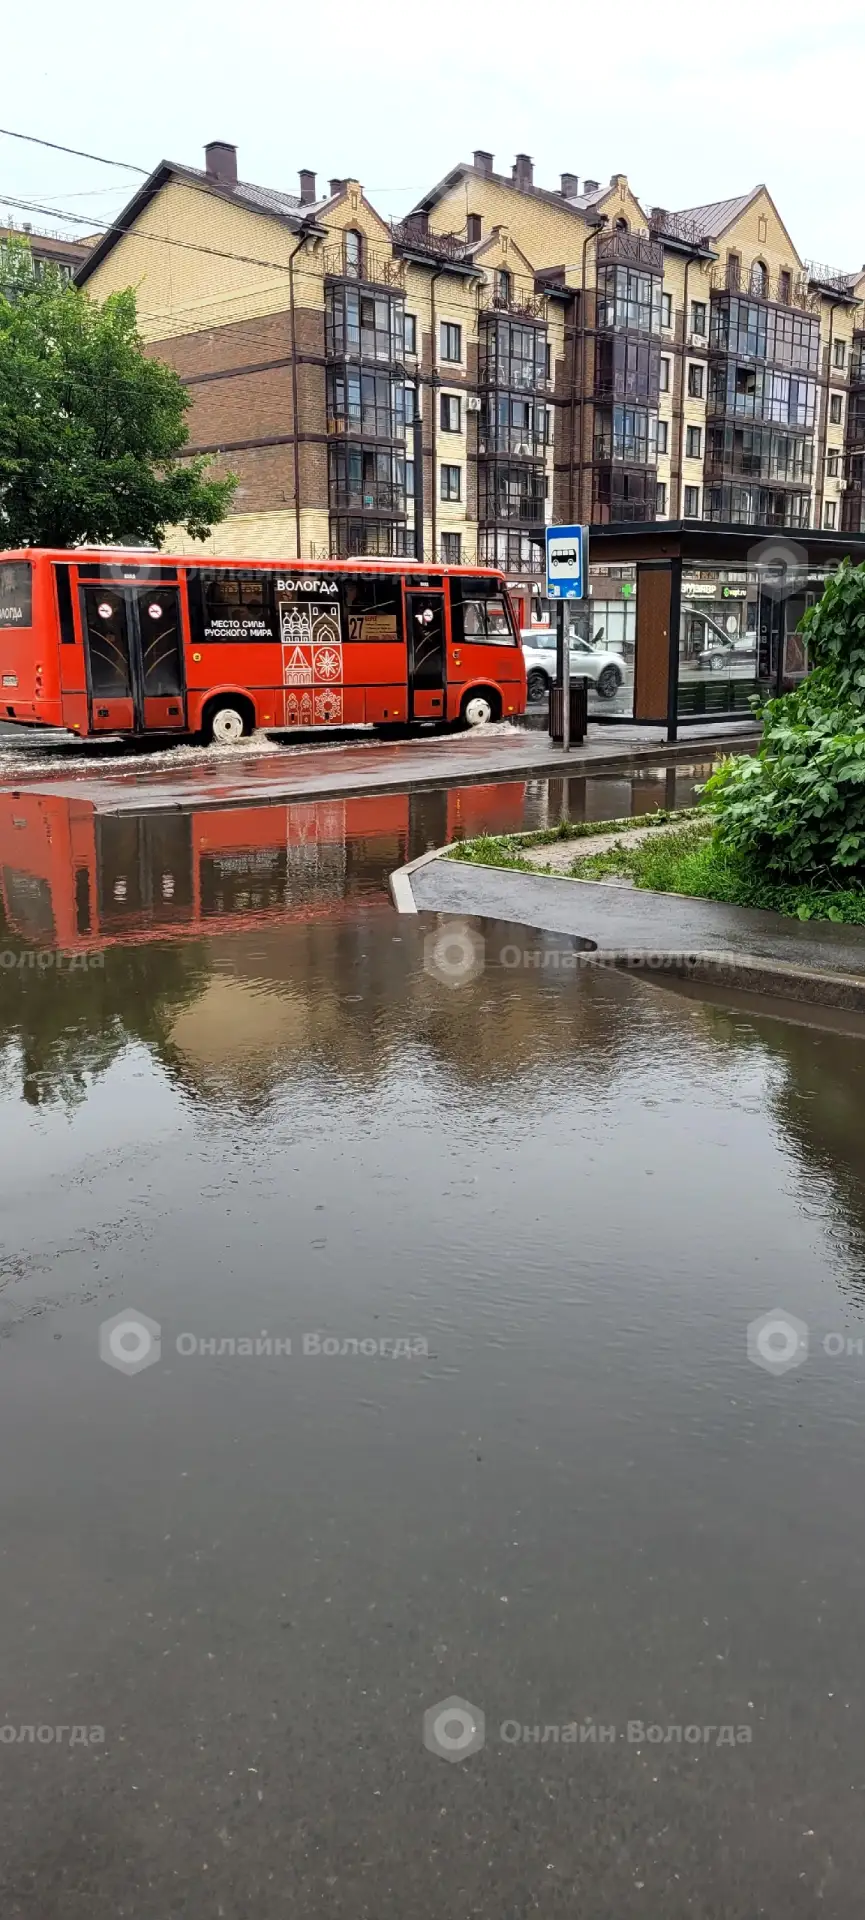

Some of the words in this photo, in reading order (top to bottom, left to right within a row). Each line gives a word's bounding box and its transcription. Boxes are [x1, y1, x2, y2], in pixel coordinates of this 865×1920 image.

[277, 580, 339, 594] ВОЛОГДА
[0, 607, 23, 622] ЛОГДА
[211, 620, 240, 628] МЕСТО
[242, 620, 266, 628] СИЛЫ
[350, 618, 364, 639] 27
[204, 628, 247, 637] РУССКОГО
[250, 628, 272, 637] МИРА
